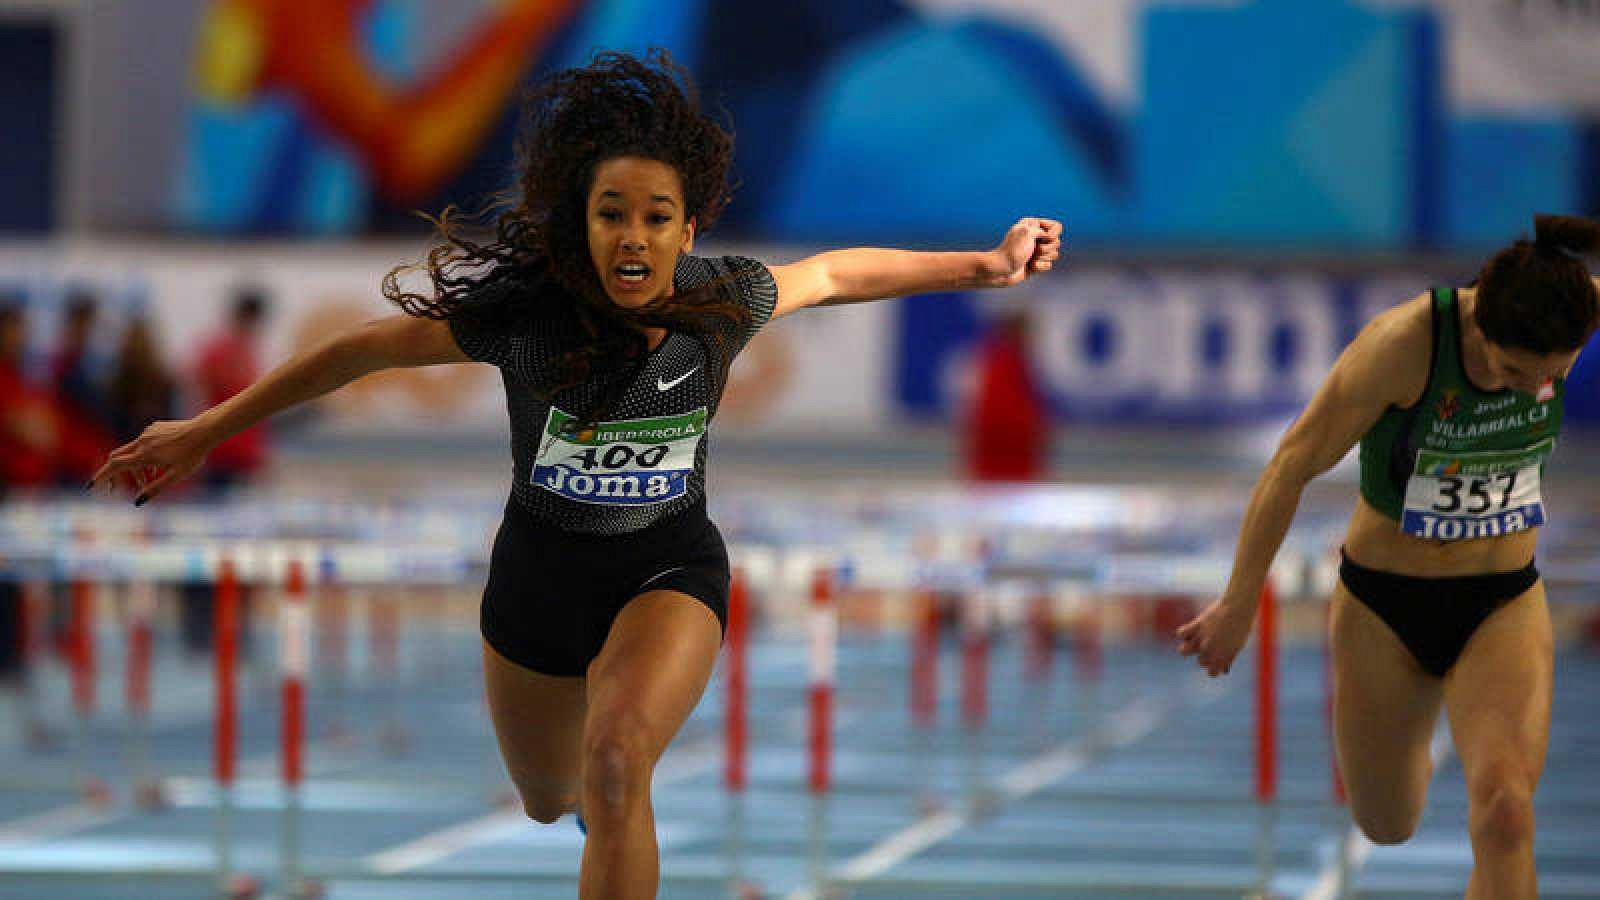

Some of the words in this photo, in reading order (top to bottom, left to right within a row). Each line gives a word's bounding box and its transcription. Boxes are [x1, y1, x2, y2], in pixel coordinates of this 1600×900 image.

[571, 444, 672, 471] 400
[546, 465, 672, 497] Joma
[1432, 472, 1519, 513] 357
